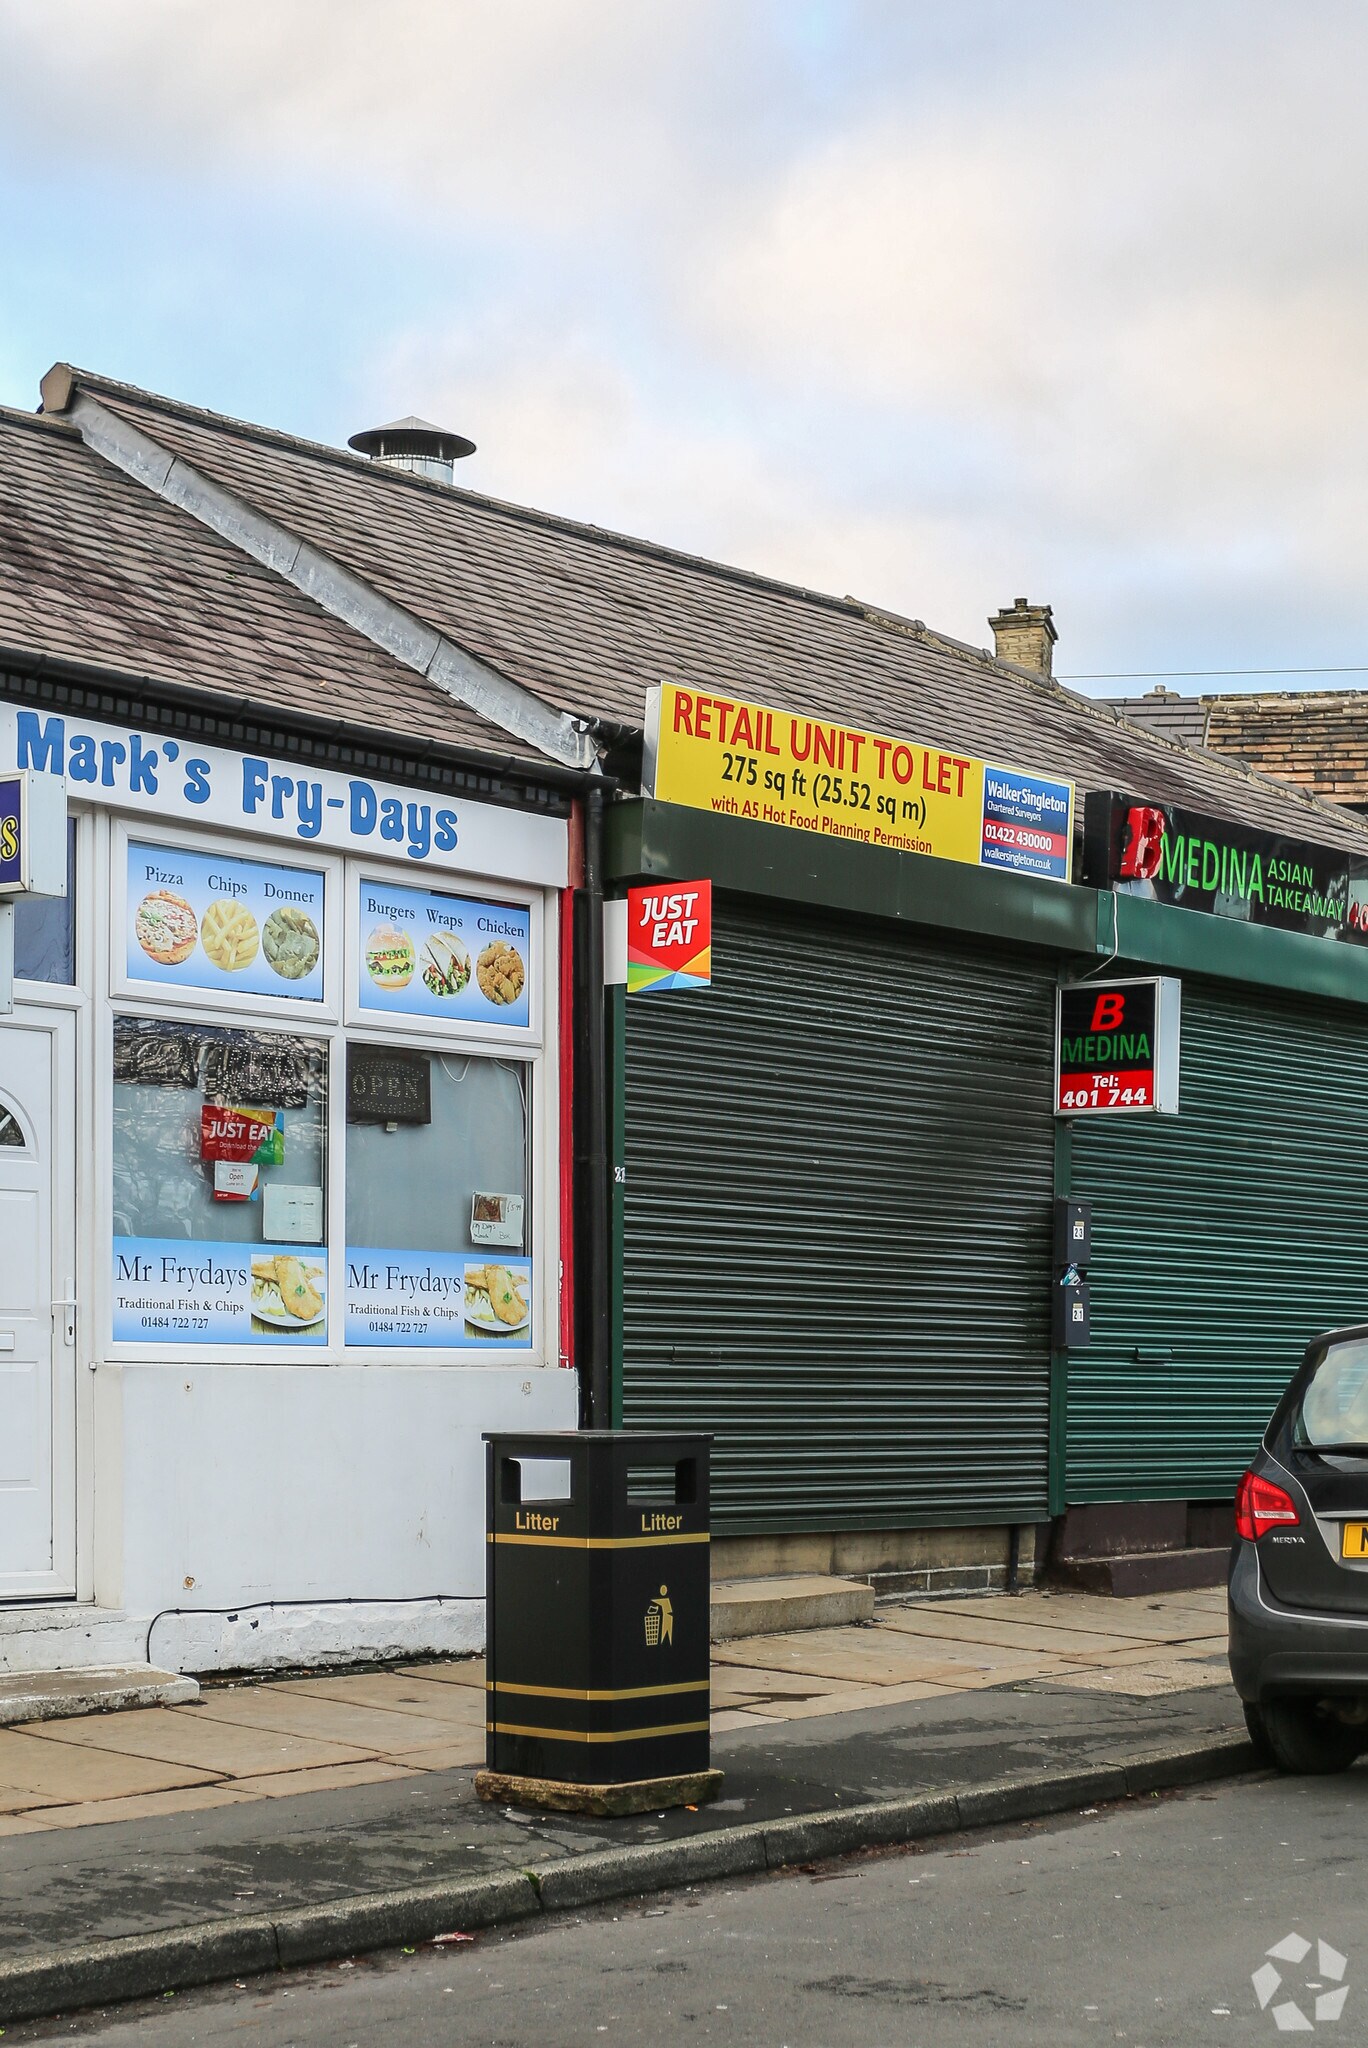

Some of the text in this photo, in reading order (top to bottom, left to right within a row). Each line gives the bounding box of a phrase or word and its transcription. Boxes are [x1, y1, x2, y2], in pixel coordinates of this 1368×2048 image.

[673, 691, 971, 798] RETAIL UNIT TO LET
[17, 711, 459, 859] Mark's Fry-Days
[721, 752, 927, 830] 275 sq ft (25.52 sq m)
[987, 800, 1041, 822] Chartered Surveyors
[711, 795, 932, 854] with A5 Hot Food Planning Permission
[985, 824, 1052, 851] 01422 430000
[984, 848, 1052, 871] walkersingleton.co.uk
[1159, 832, 1265, 903] MEDINA
[144, 865, 315, 904] Pizza Chips Donner
[1267, 858, 1314, 889] ASIAN
[639, 892, 699, 927] JUST
[1266, 884, 1344, 922] TAKEAWAY
[367, 898, 525, 938] Burgers Wraps Chicken
[651, 919, 699, 948] EAT
[1090, 993, 1126, 1032] B
[1061, 1033, 1151, 1063] MEDINA
[352, 1074, 419, 1098] OPEN
[1092, 1075, 1119, 1088] Tel:
[1062, 1088, 1147, 1107] 401 744
[209, 1121, 277, 1142] JUST EAT
[229, 1172, 244, 1181] Open
[1074, 1227, 1083, 1238] 23
[116, 1254, 248, 1293] Mr Frydays
[347, 1264, 461, 1300] Mr Frydays
[116, 1297, 245, 1315] Traditional Fish & Chips
[348, 1303, 459, 1320] Traditional Fish & Chips
[1073, 1309, 1083, 1320] 21
[141, 1316, 209, 1329] 01484 722 727
[368, 1321, 428, 1334] 01484 722 727
[515, 1511, 560, 1531] Litter
[641, 1513, 683, 1532] Litter
[1272, 1536, 1306, 1544] MERIVA
